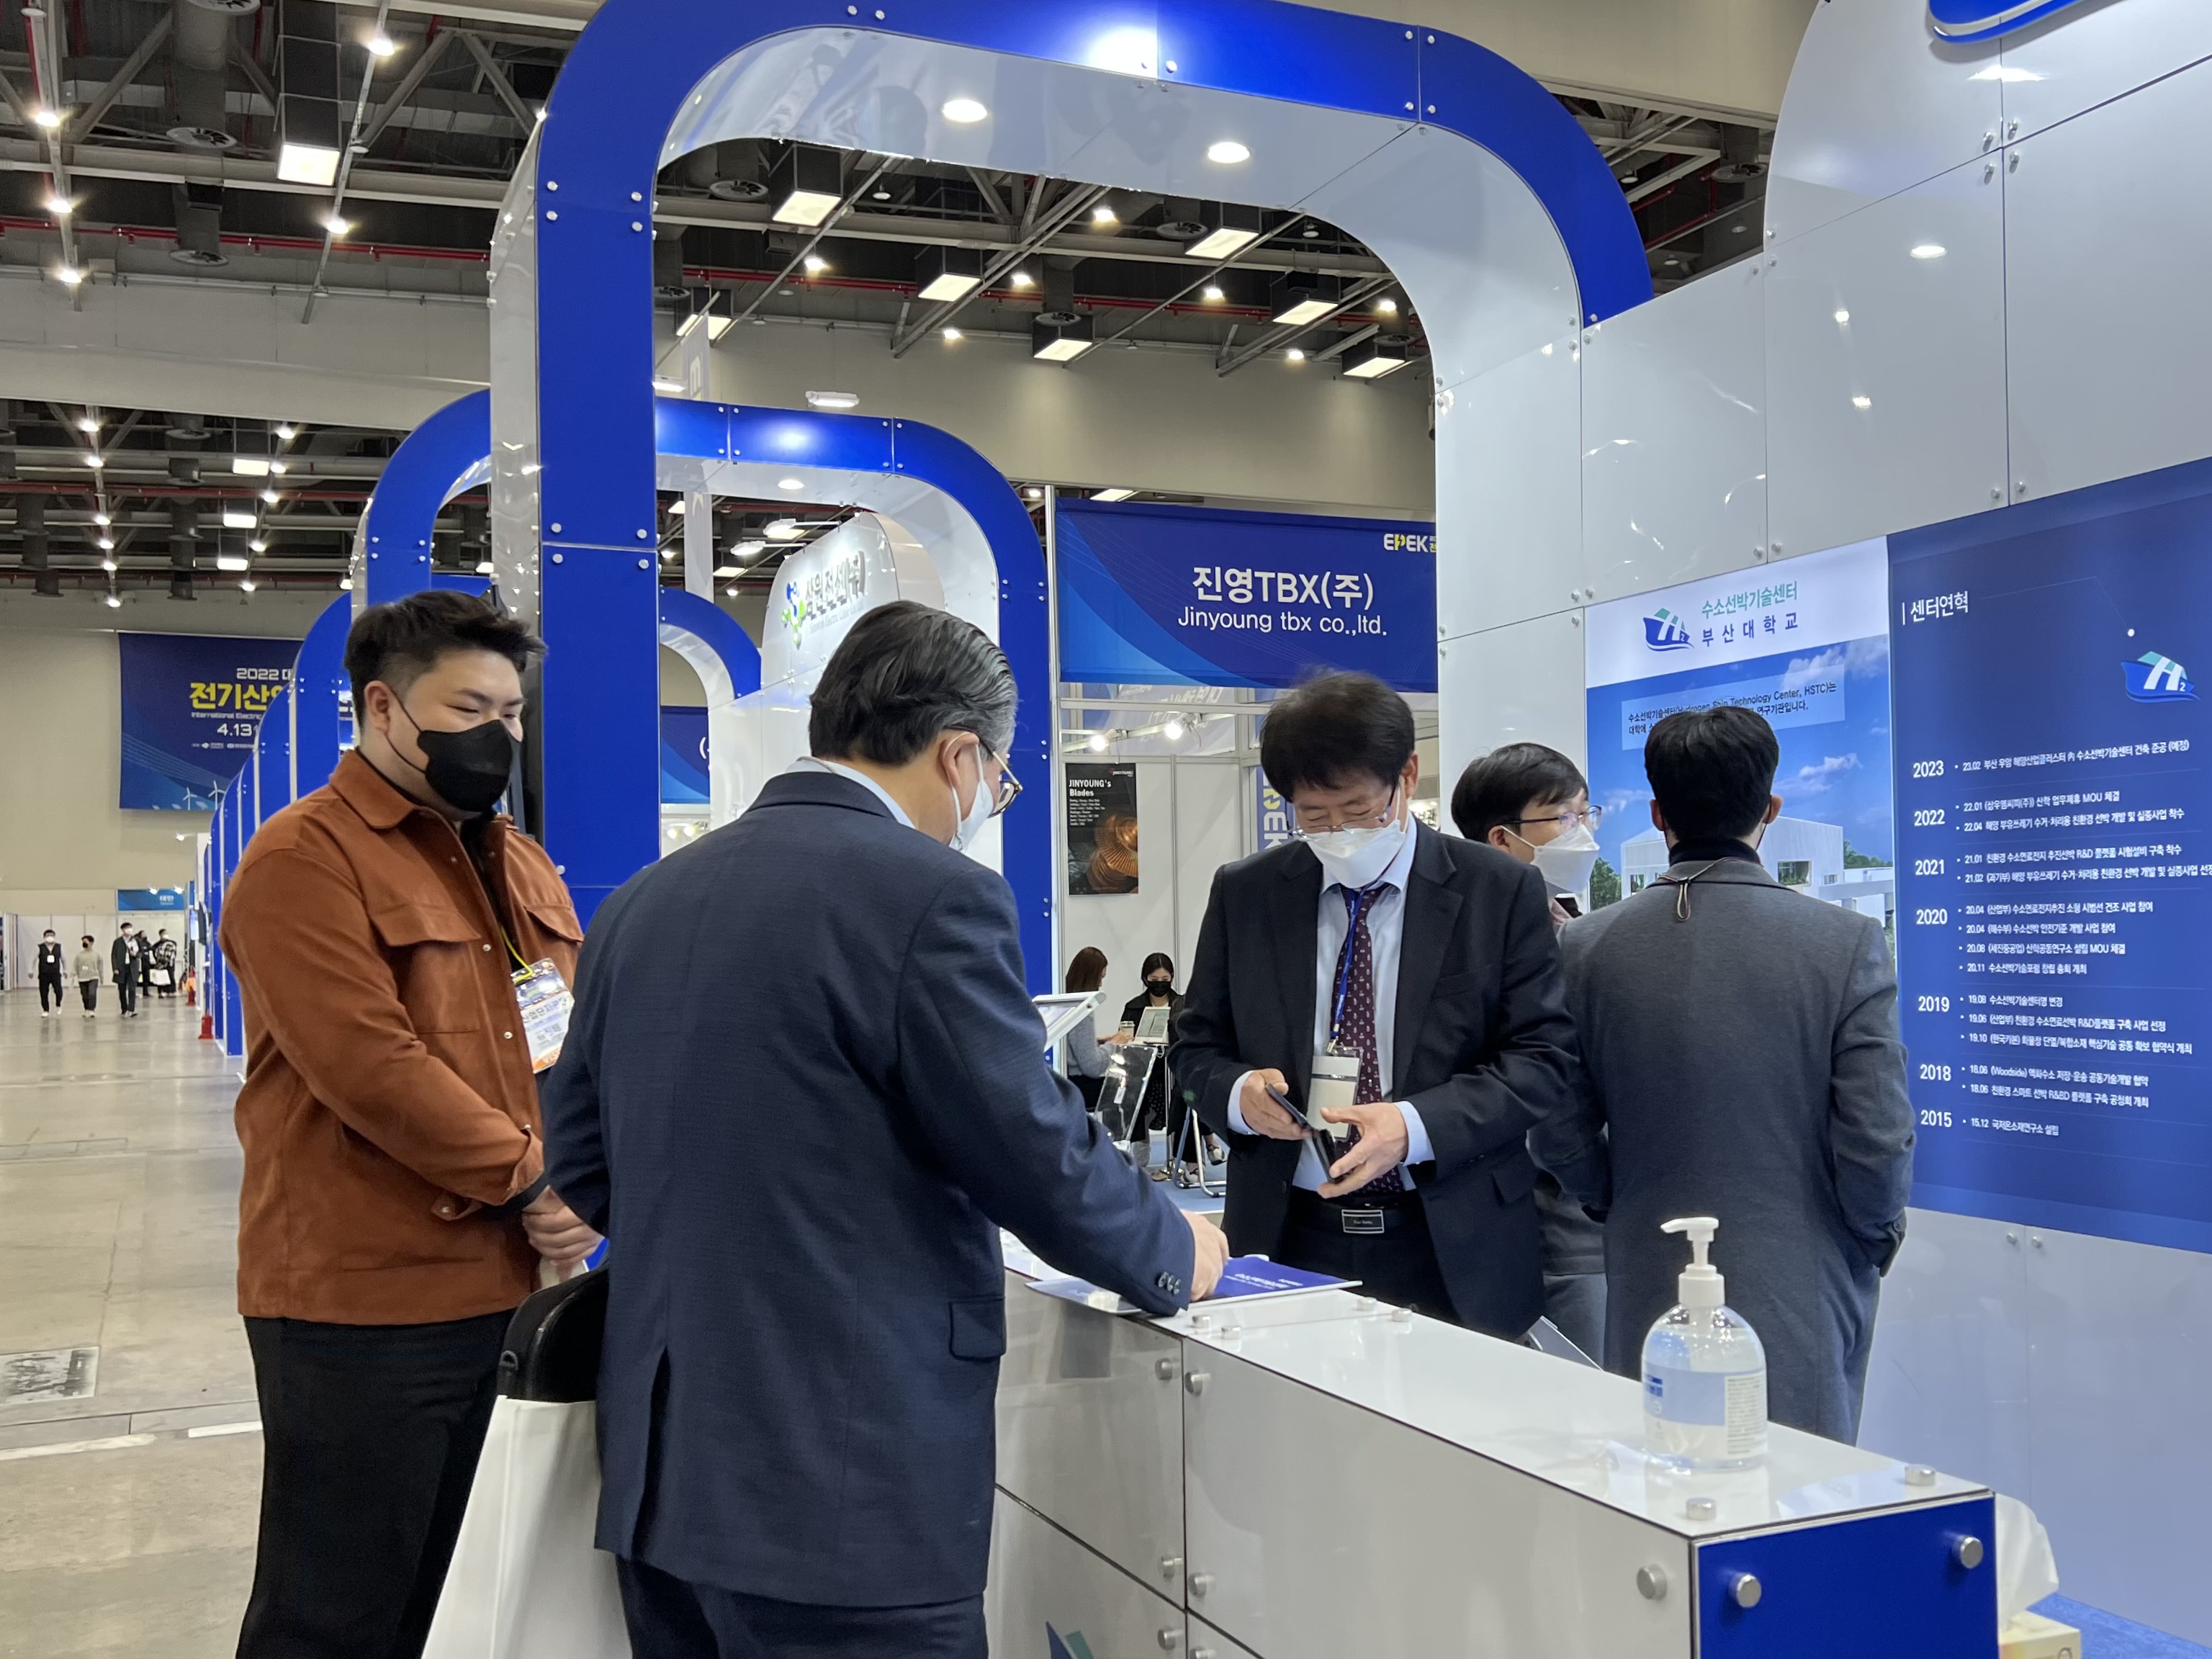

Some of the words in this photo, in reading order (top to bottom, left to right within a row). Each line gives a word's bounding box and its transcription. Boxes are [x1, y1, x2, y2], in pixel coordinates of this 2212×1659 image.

[1192, 566, 1375, 610] 진영TBX(주)
[1701, 580, 1797, 619] 수소선박기술센터
[1910, 590, 1969, 623] 센터연혁
[1178, 606, 1273, 633] Jinyoung
[1280, 612, 1311, 631] tbx
[236, 667, 279, 680] 2022
[1730, 693, 1771, 707] Technology
[1963, 761, 1981, 772] 23.02
[1984, 759, 1997, 770] 부산
[2077, 745, 2133, 761] 수소선박기술센터
[2135, 743, 2149, 755] 건축
[1913, 760, 1944, 778] 2023
[1069, 778, 1111, 788] JINYOUNG's
[1069, 788, 1094, 797] Blades
[1964, 801, 1982, 812] 22.01
[2082, 792, 2103, 803] MOU
[1914, 809, 1946, 827] 2022
[1964, 822, 1982, 832] 22.04
[2072, 814, 2093, 826] 친환경
[2095, 813, 2110, 824] 선박
[2111, 811, 2126, 823] 개발
[1964, 854, 1982, 864] 21.01
[1987, 853, 2005, 863] 친환경
[2149, 845, 2164, 856] 구축
[1915, 858, 1945, 876] 2021
[1965, 873, 1984, 883] 21.02
[2100, 868, 2123, 879] 친환경
[2124, 867, 2139, 878] 선박
[2141, 866, 2156, 878] 개발
[1966, 905, 1984, 914] 20.04
[2121, 902, 2136, 912] 사업
[2138, 901, 2153, 912] 참여
[1916, 908, 1948, 925] 2020
[1966, 925, 1984, 934] 20.04
[2085, 922, 2099, 934] 사업
[2101, 922, 2116, 934] 참여
[2090, 944, 2109, 954] MOU
[1967, 963, 1985, 973] 20.11
[1918, 996, 1950, 1012] 2019
[2134, 1020, 2149, 1031] 사업
[1969, 1033, 1987, 1043] 19.10
[1920, 1064, 1951, 1081] 2018
[1970, 1065, 1988, 1075] 18.06
[1970, 1084, 1989, 1094] 18.06
[1920, 1110, 1952, 1128] 2015
[1971, 1118, 1989, 1128] 15.12
